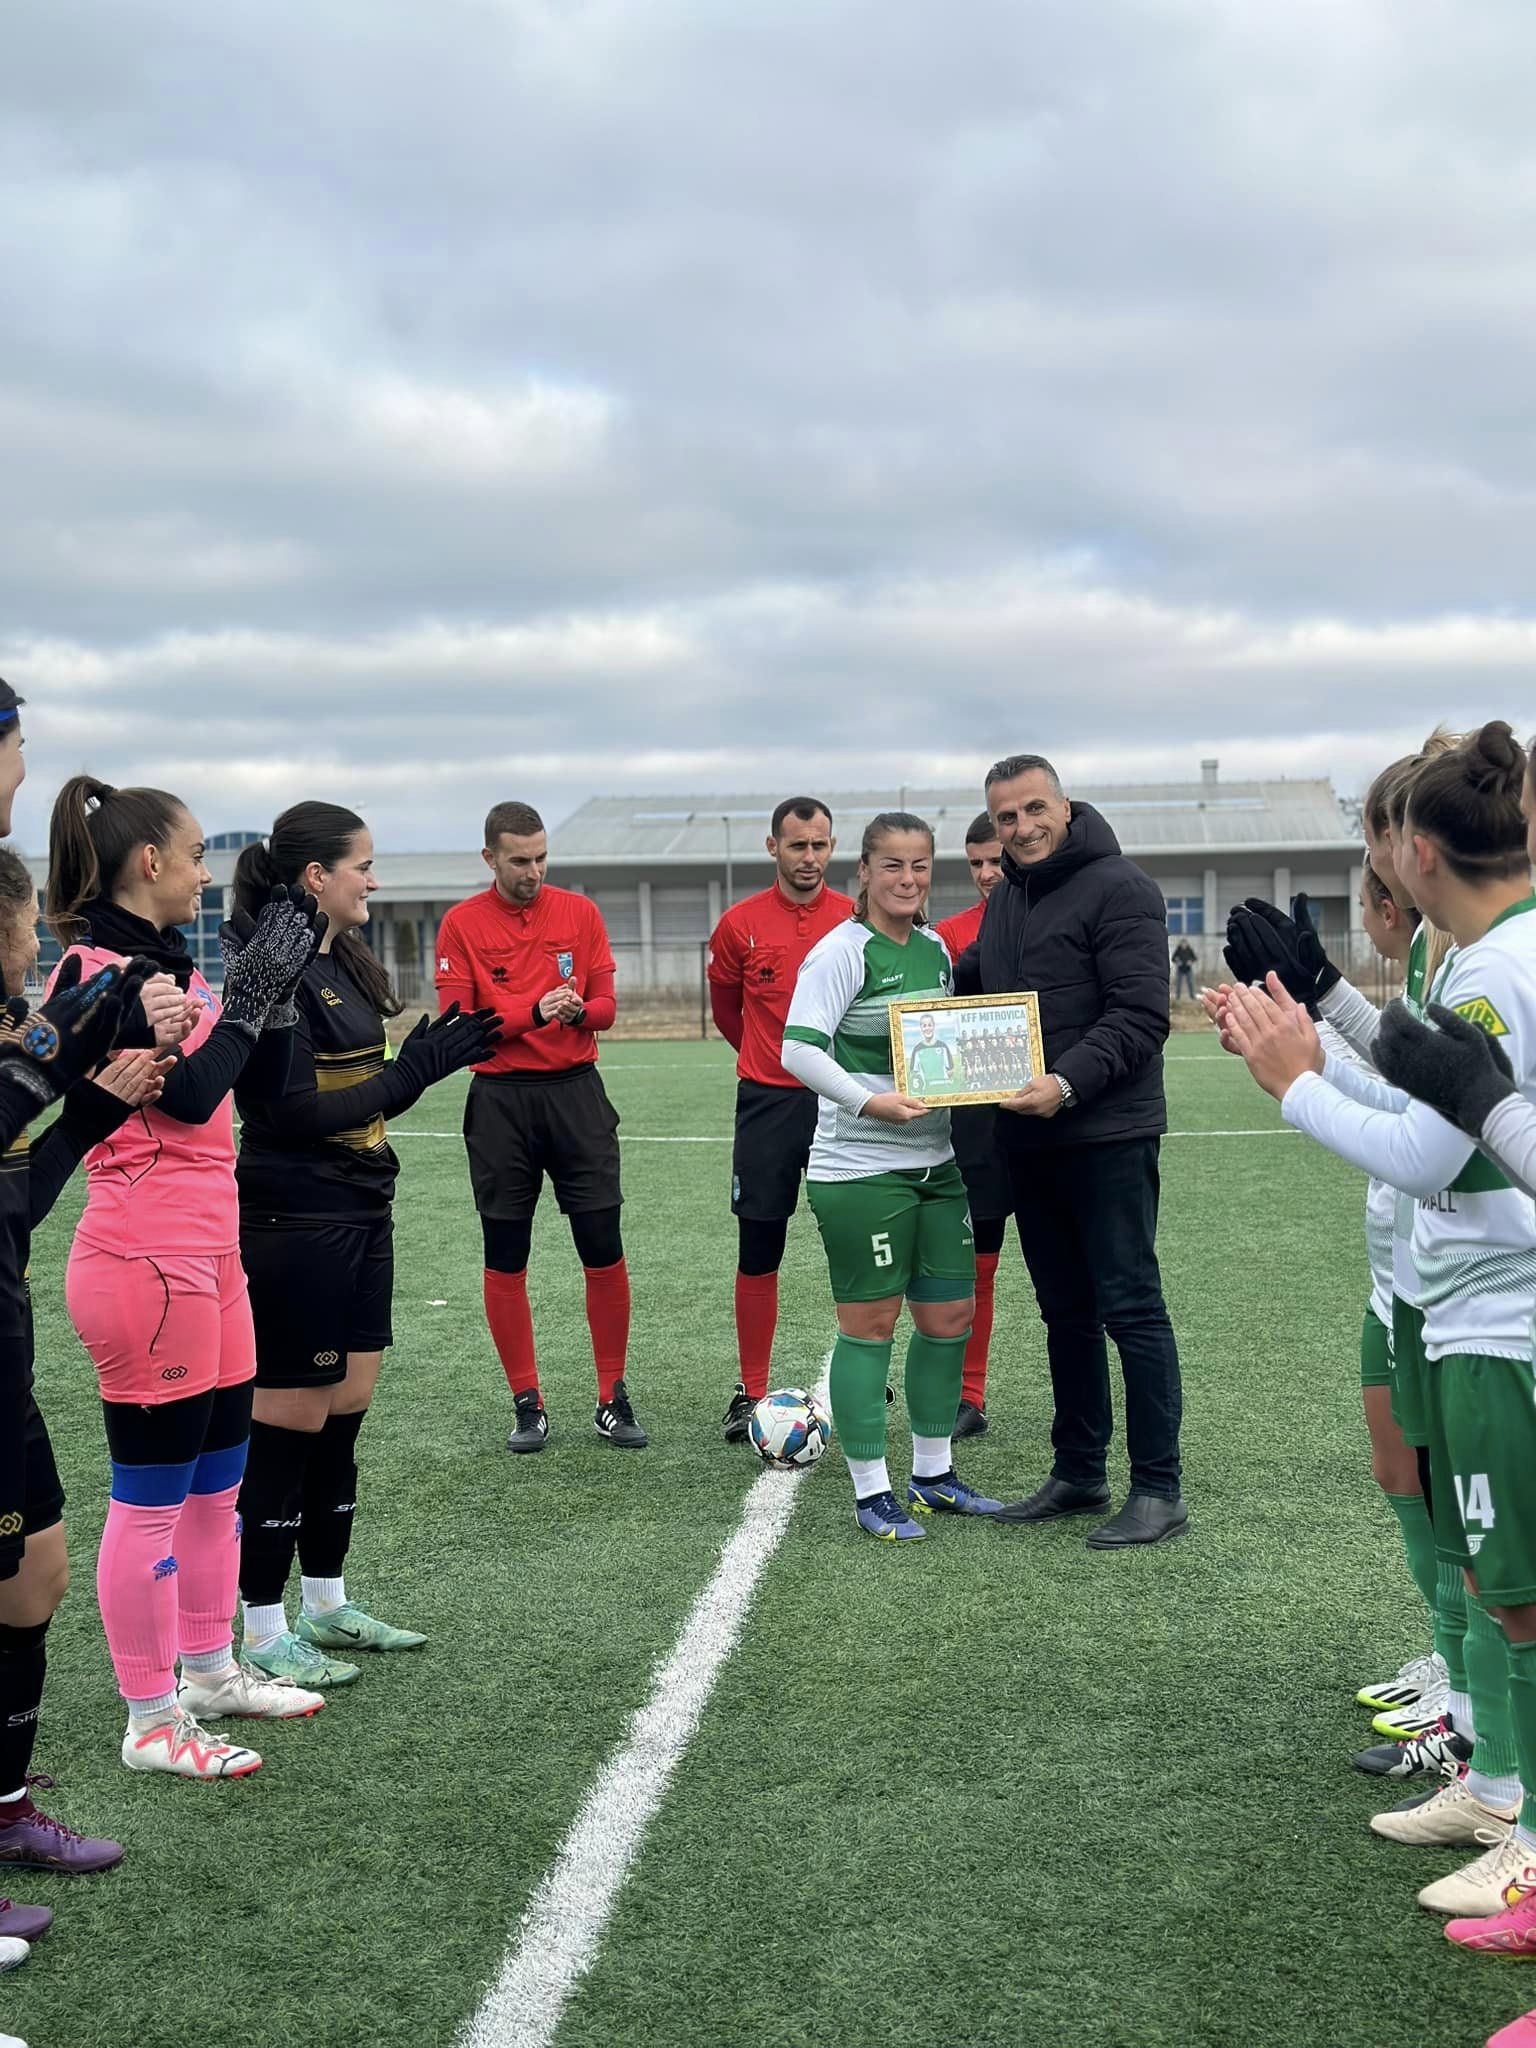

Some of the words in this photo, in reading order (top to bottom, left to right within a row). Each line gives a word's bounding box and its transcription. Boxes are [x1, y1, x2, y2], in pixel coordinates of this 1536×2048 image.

[960, 1012, 977, 1024] KFF
[979, 1008, 1026, 1022] MITROVICA
[871, 1232, 893, 1268] 5
